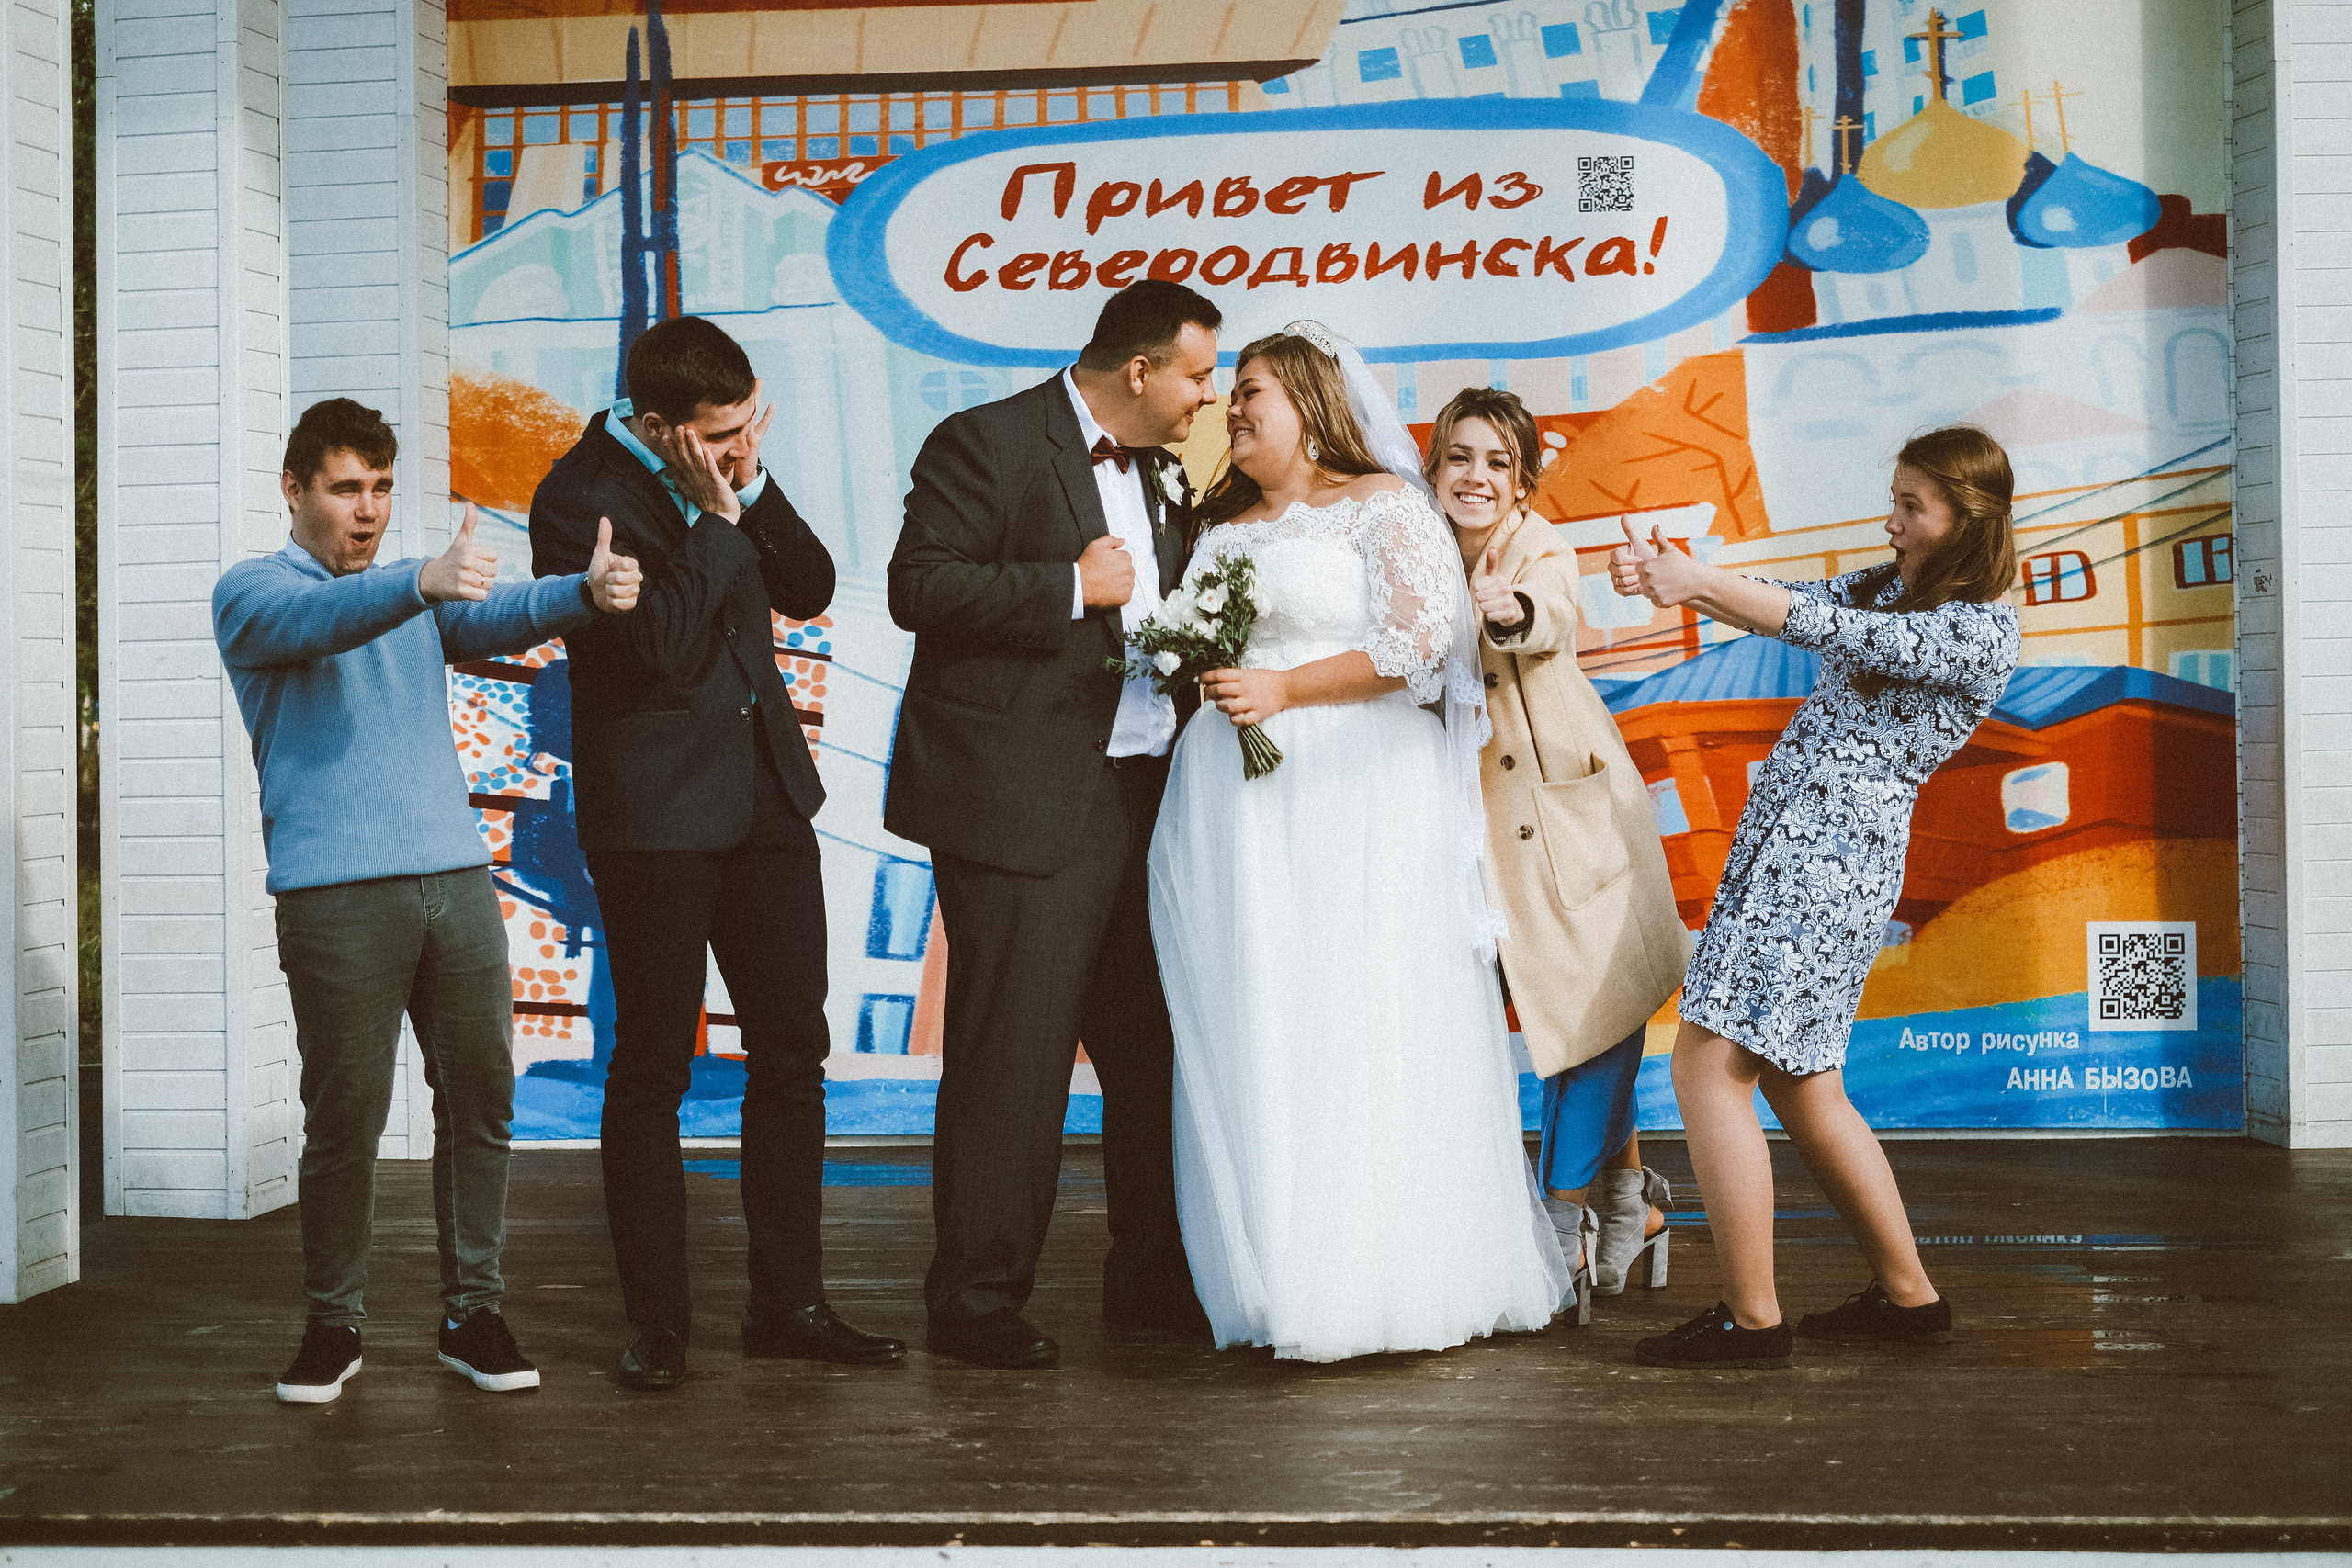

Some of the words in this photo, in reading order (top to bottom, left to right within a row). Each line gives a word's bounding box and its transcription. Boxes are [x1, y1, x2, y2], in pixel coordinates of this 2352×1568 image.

[1000, 160, 1386, 235] Привет
[1423, 170, 1544, 211] из
[944, 215, 1669, 293] Северодвинска!
[1899, 1027, 1971, 1055] Автор
[1982, 1032, 2080, 1057] рисунка
[2007, 1066, 2075, 1091] АННА
[2085, 1066, 2193, 1091] БЫЗОВА
